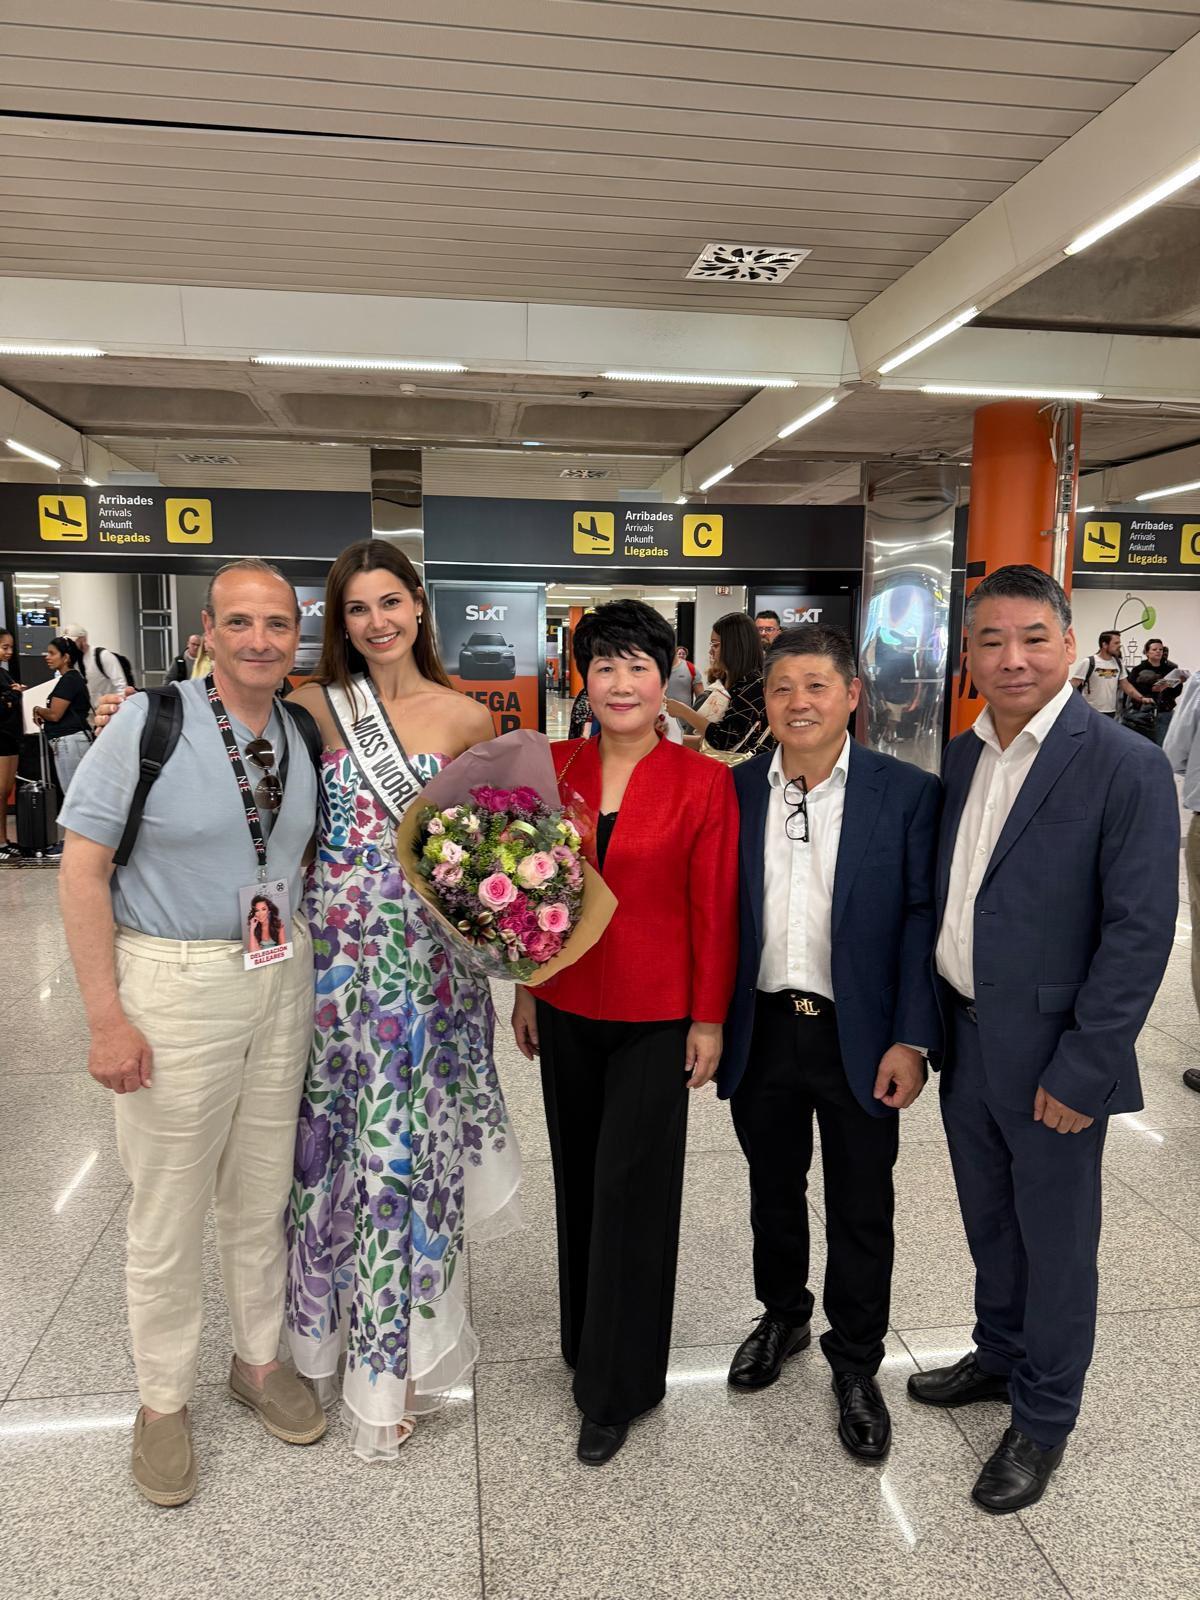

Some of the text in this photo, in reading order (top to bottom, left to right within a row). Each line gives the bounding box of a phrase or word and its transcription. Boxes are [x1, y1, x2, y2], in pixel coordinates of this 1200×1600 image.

[98, 494, 154, 506] Arribades
[98, 507, 133, 517] Arrivals
[625, 510, 674, 521] Arribades
[99, 519, 133, 530] Ankunft
[178, 507, 200, 535] C
[1130, 520, 1174, 531] Arribades
[625, 523, 654, 532] Arrivals
[99, 532, 151, 544] Llegadas
[624, 534, 654, 544] Ankunft
[693, 522, 712, 548] C
[1129, 532, 1156, 541] Arrivals
[624, 546, 669, 557] Llegadas
[1129, 543, 1155, 552] Ankunft
[1128, 553, 1168, 565] Llegadas
[350, 714, 418, 813] MISS WORL
